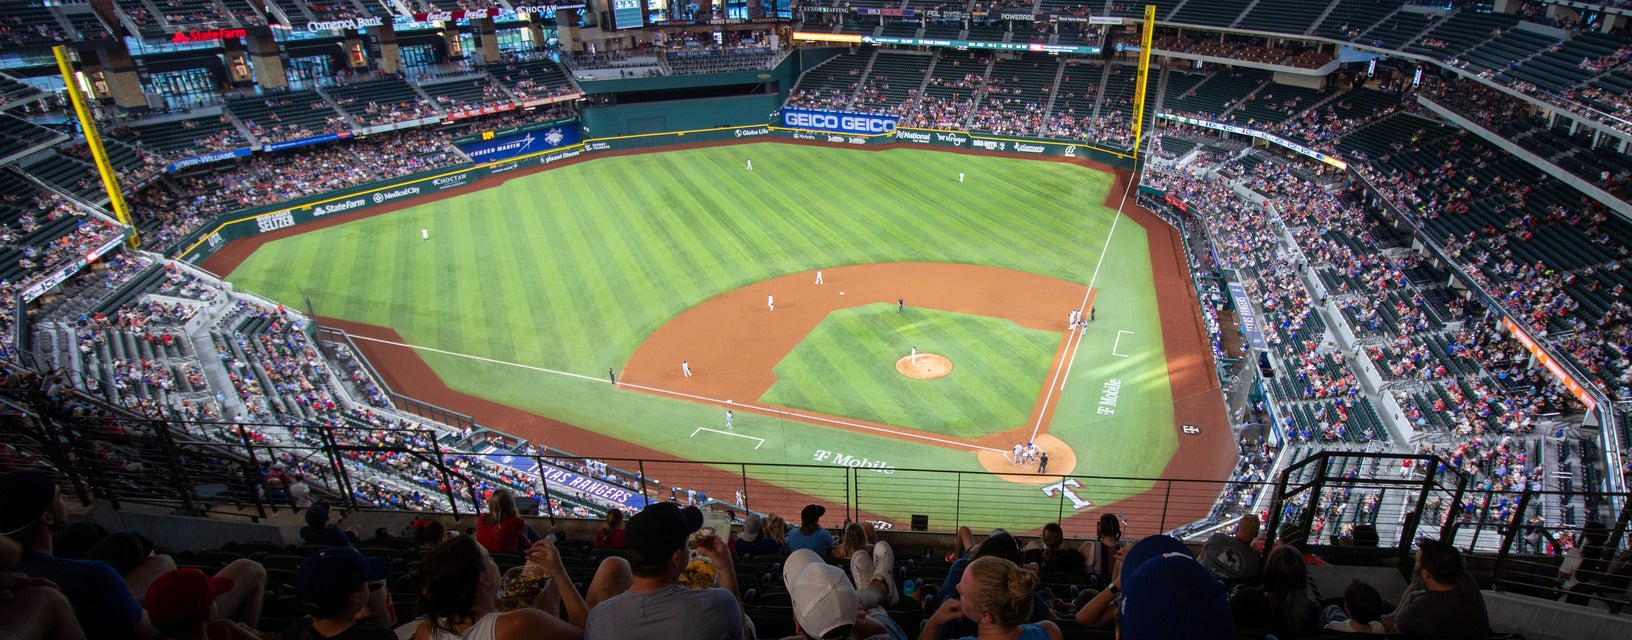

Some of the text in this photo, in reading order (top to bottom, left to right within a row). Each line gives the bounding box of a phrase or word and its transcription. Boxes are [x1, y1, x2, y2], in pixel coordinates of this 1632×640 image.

[463, 9, 489, 20] Coca-Cola
[520, 4, 557, 14] CHOCTAW
[355, 16, 384, 26] Bank
[427, 11, 453, 22] Coca-Cola
[1000, 13, 1036, 21] POWERADE
[785, 112, 897, 132] GEICO GEICO
[903, 131, 931, 140] National
[946, 132, 967, 146] Kroger
[497, 142, 521, 152] MARTIN
[545, 150, 580, 164] planet fitness
[437, 173, 467, 185] CHOCTAW
[384, 186, 421, 200] Medical City
[257, 214, 296, 233] SELTZER
[1099, 378, 1122, 407] Mobile
[832, 453, 895, 475] Mobile
[526, 462, 633, 504] TEXAS RANGERS
